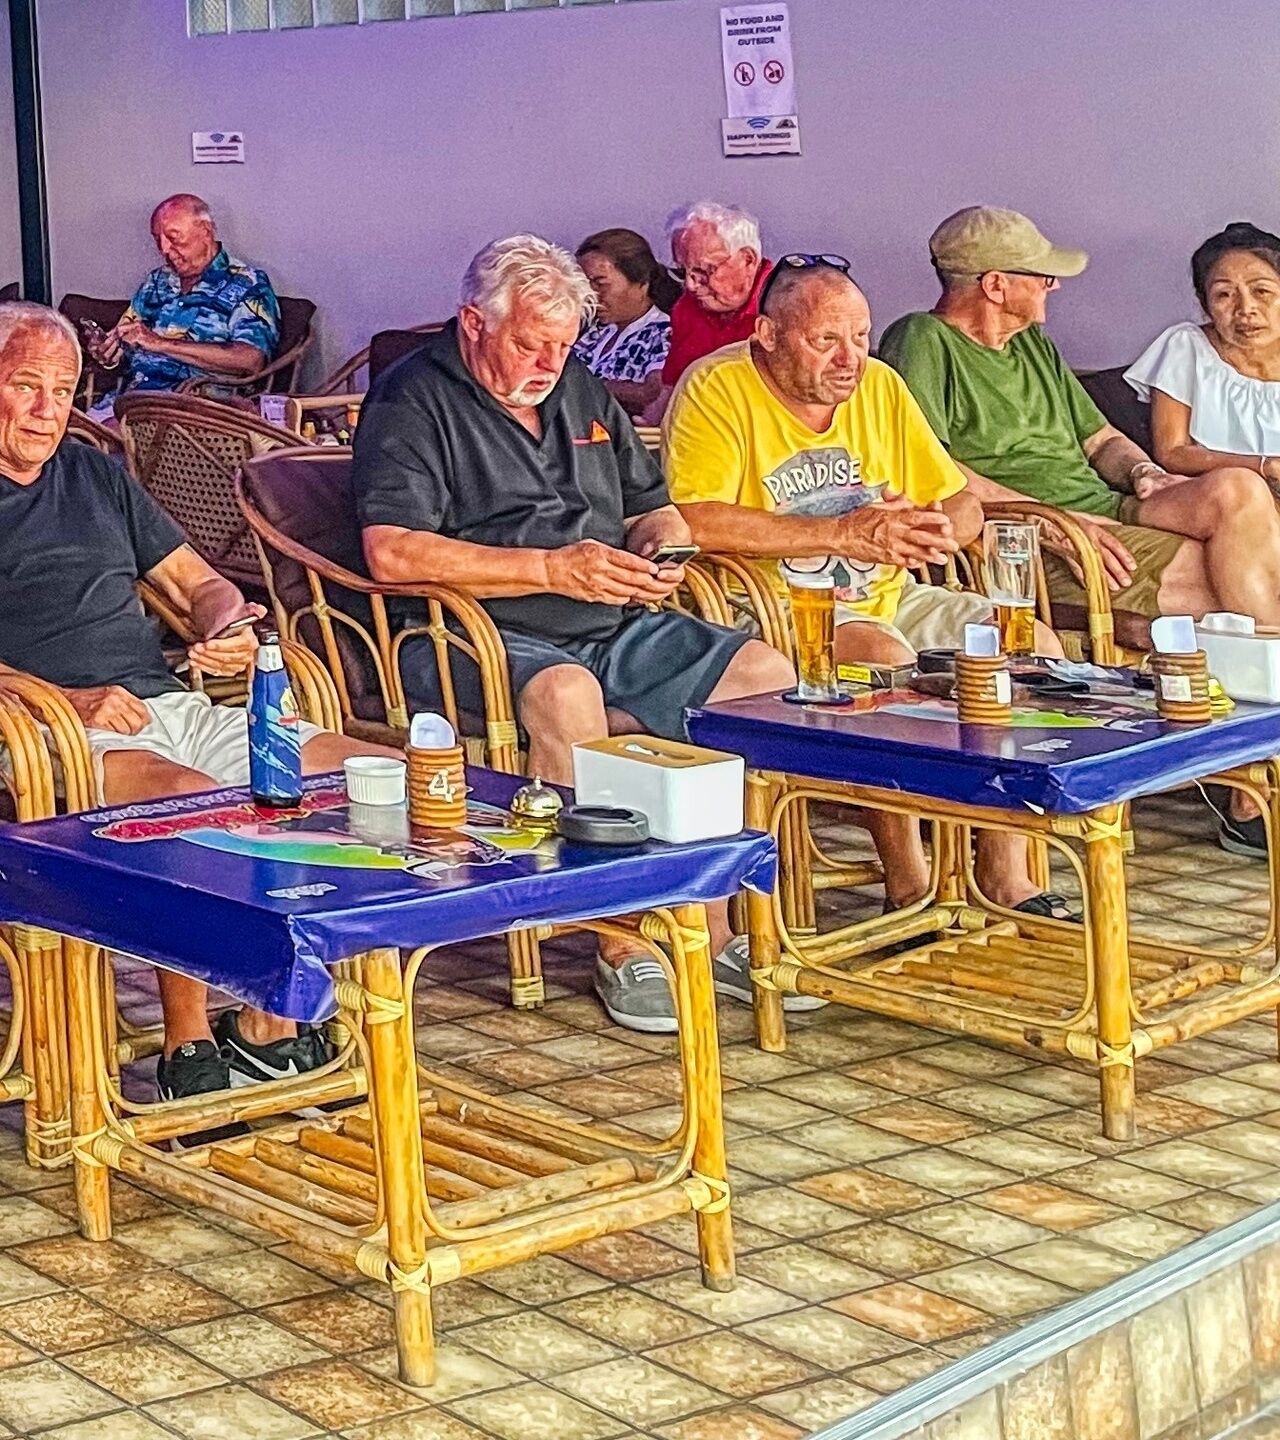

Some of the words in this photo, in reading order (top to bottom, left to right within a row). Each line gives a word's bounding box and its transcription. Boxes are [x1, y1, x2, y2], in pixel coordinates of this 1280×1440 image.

[740, 16, 764, 25] FOOD
[765, 14, 784, 22] AND
[756, 26, 781, 34] FROM
[738, 37, 775, 46] OUTSIDE
[762, 458, 863, 504] PARADISE
[428, 768, 456, 804] 4
